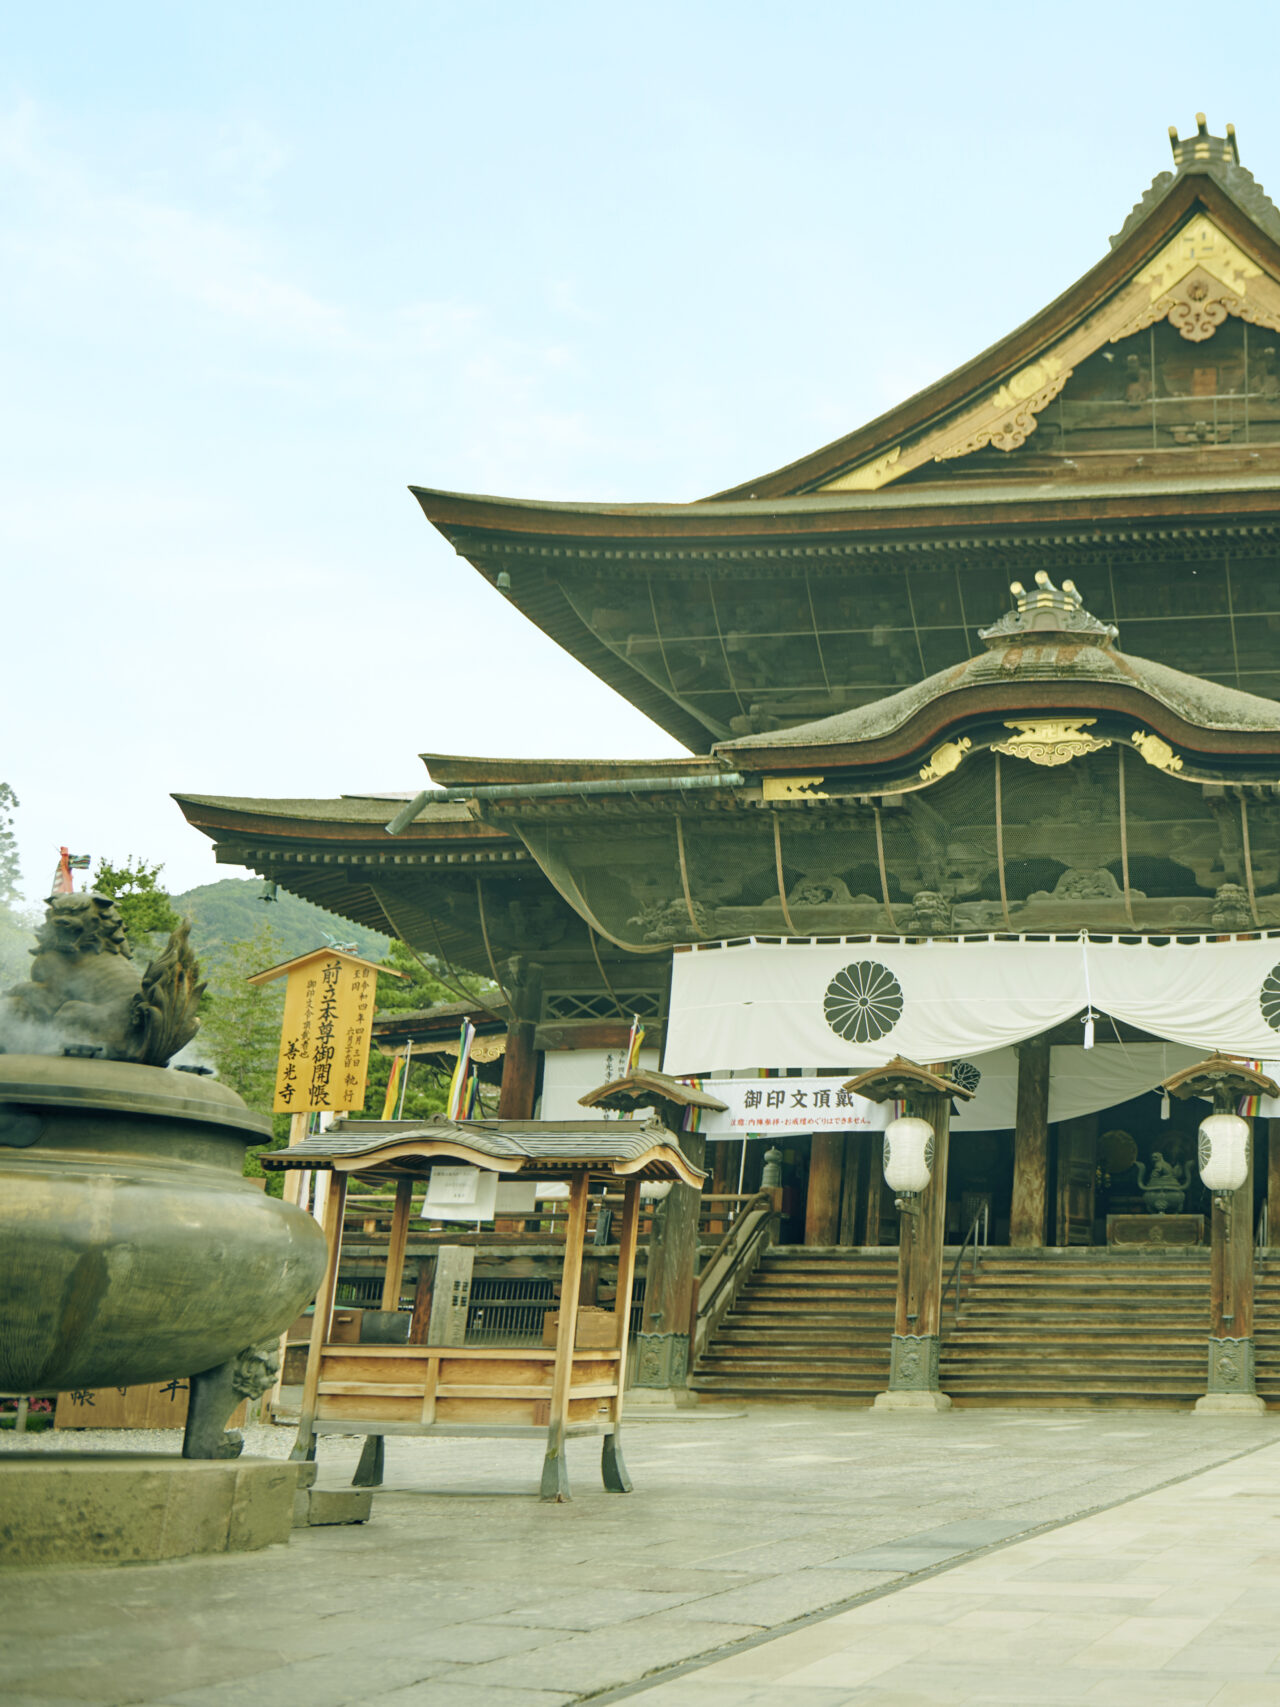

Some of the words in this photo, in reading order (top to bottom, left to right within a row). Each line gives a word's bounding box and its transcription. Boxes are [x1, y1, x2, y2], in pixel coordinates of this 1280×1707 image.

[308, 960, 342, 1106] 前立本尊御開帳
[279, 1038, 300, 1104] 善光寺
[743, 1088, 855, 1110] 御印文頂戴
